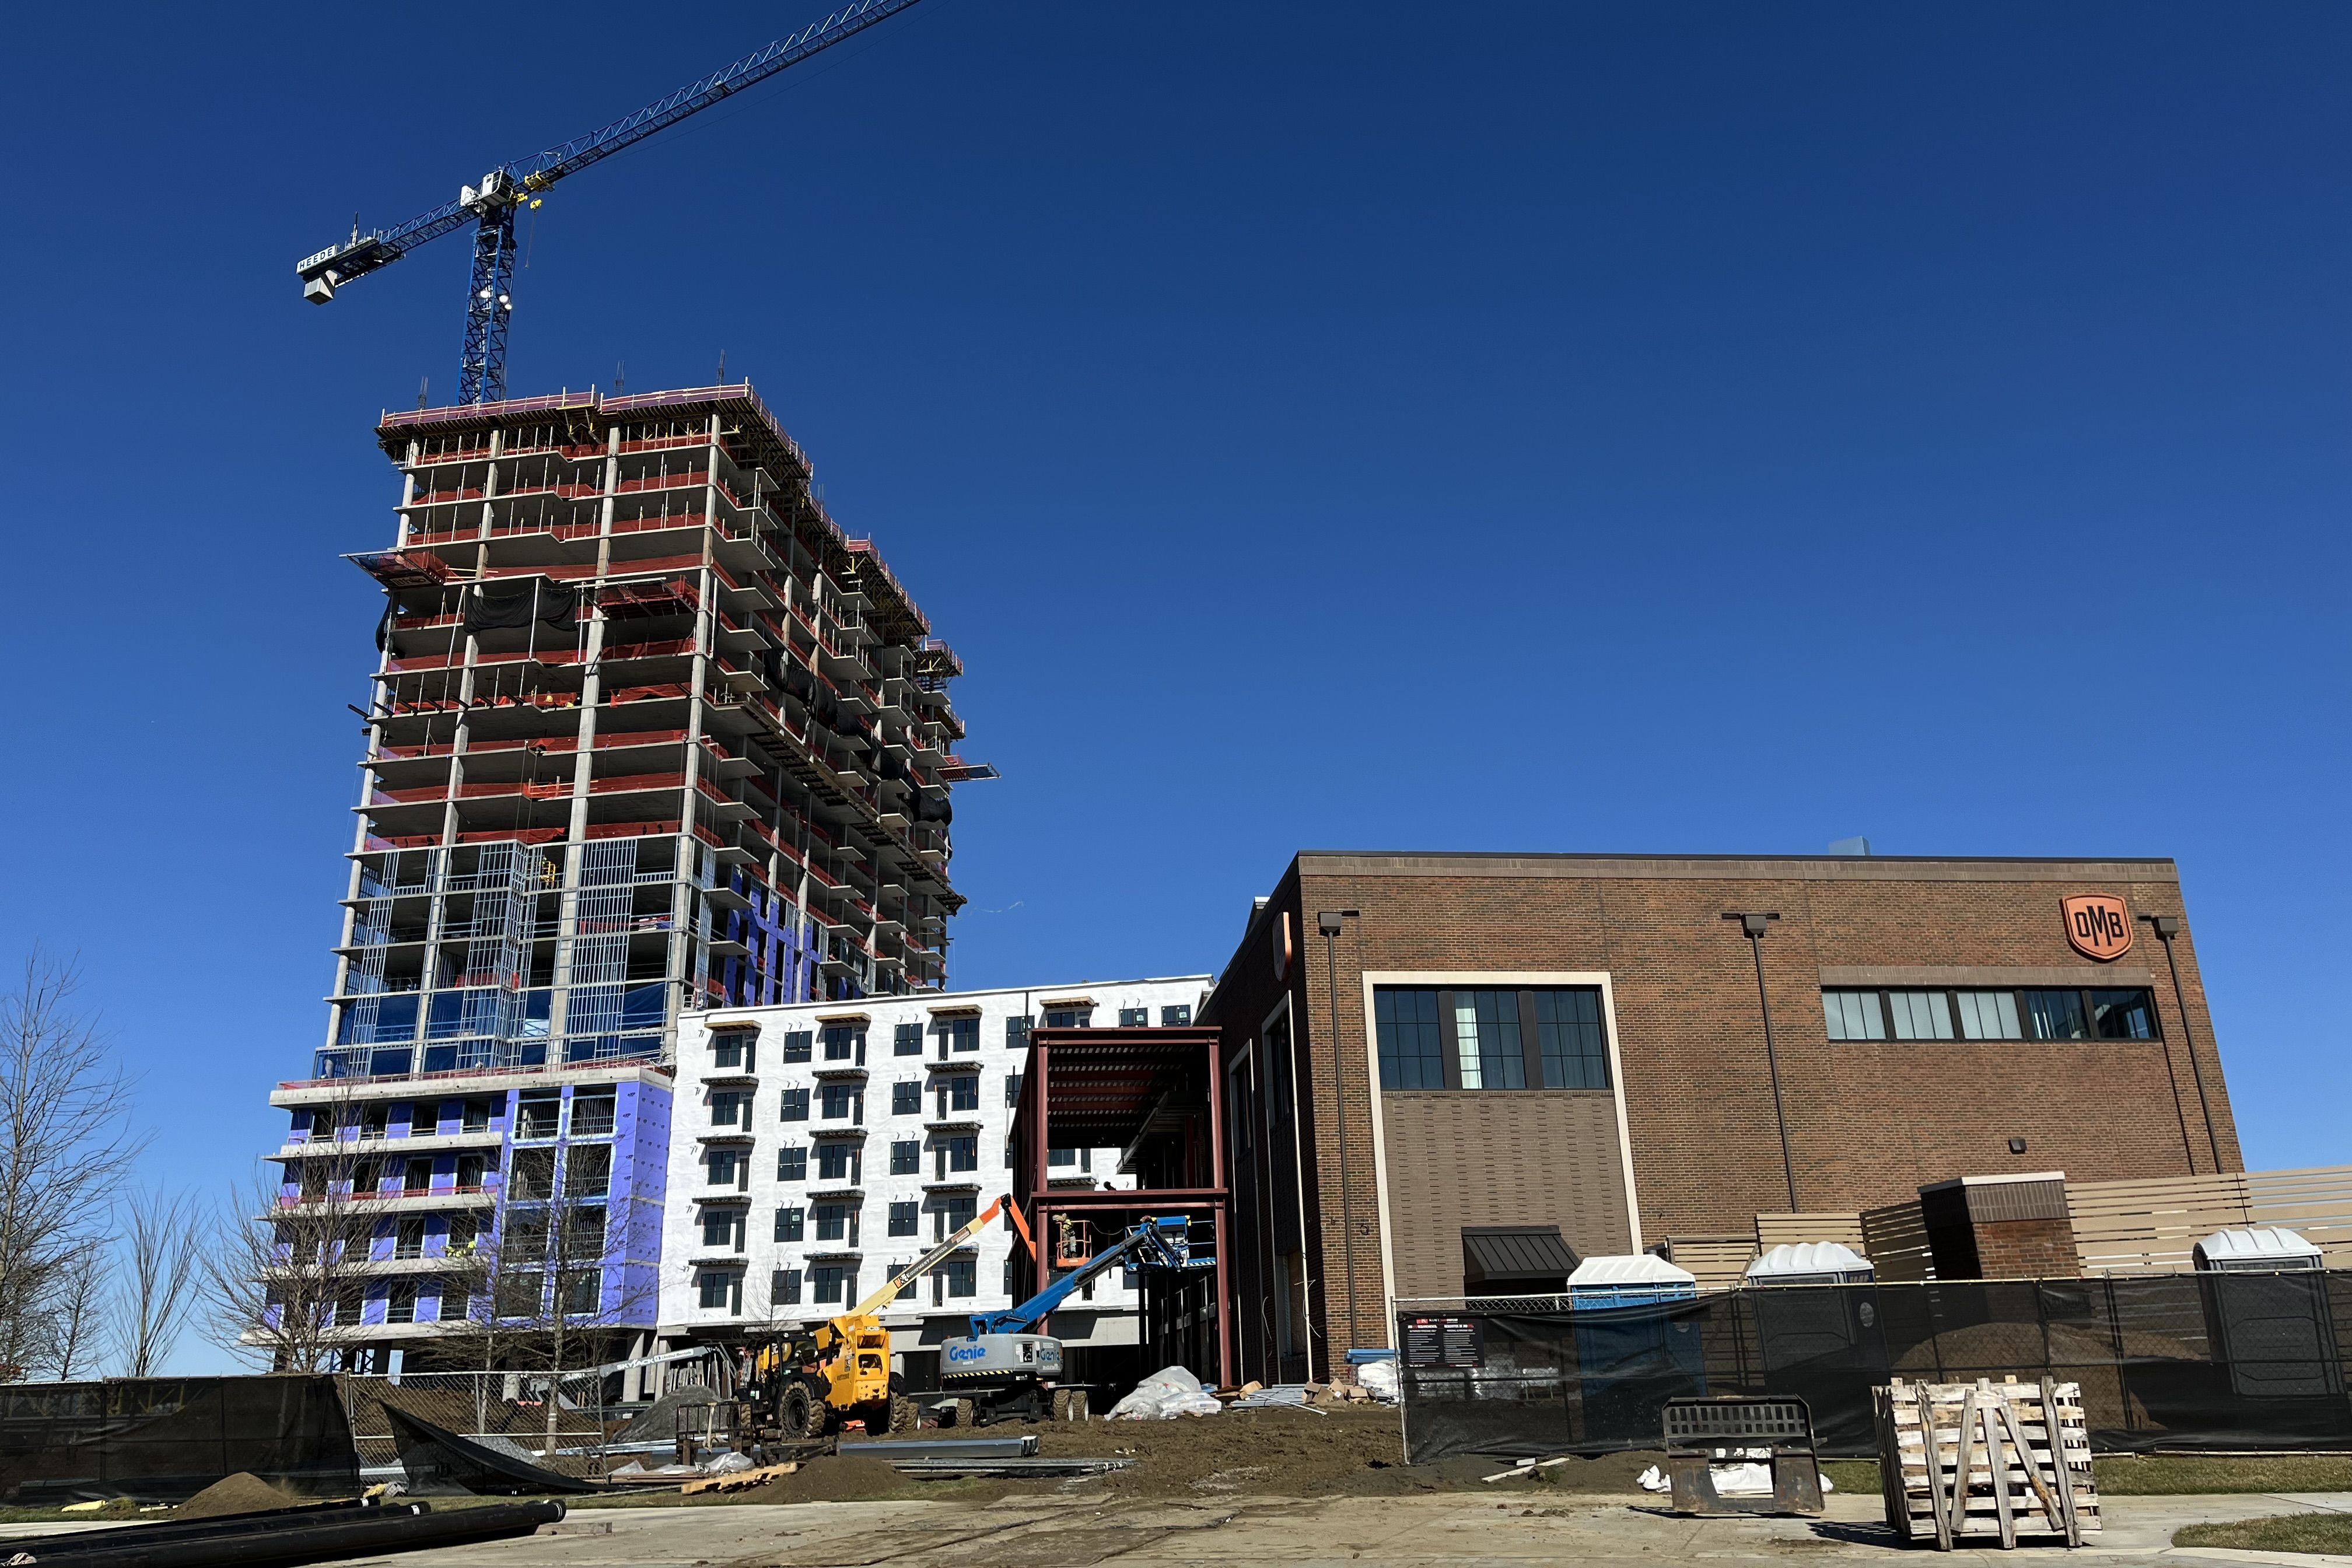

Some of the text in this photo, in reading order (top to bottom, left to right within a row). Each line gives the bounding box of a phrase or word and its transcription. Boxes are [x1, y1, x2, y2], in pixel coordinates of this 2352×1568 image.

[299, 247, 332, 270] HEEDE
[2074, 905, 2124, 946] OMB
[949, 1345, 986, 1362] Genie
[1040, 1348, 1060, 1361] Genie
[617, 1359, 654, 1371] SKYJACK
